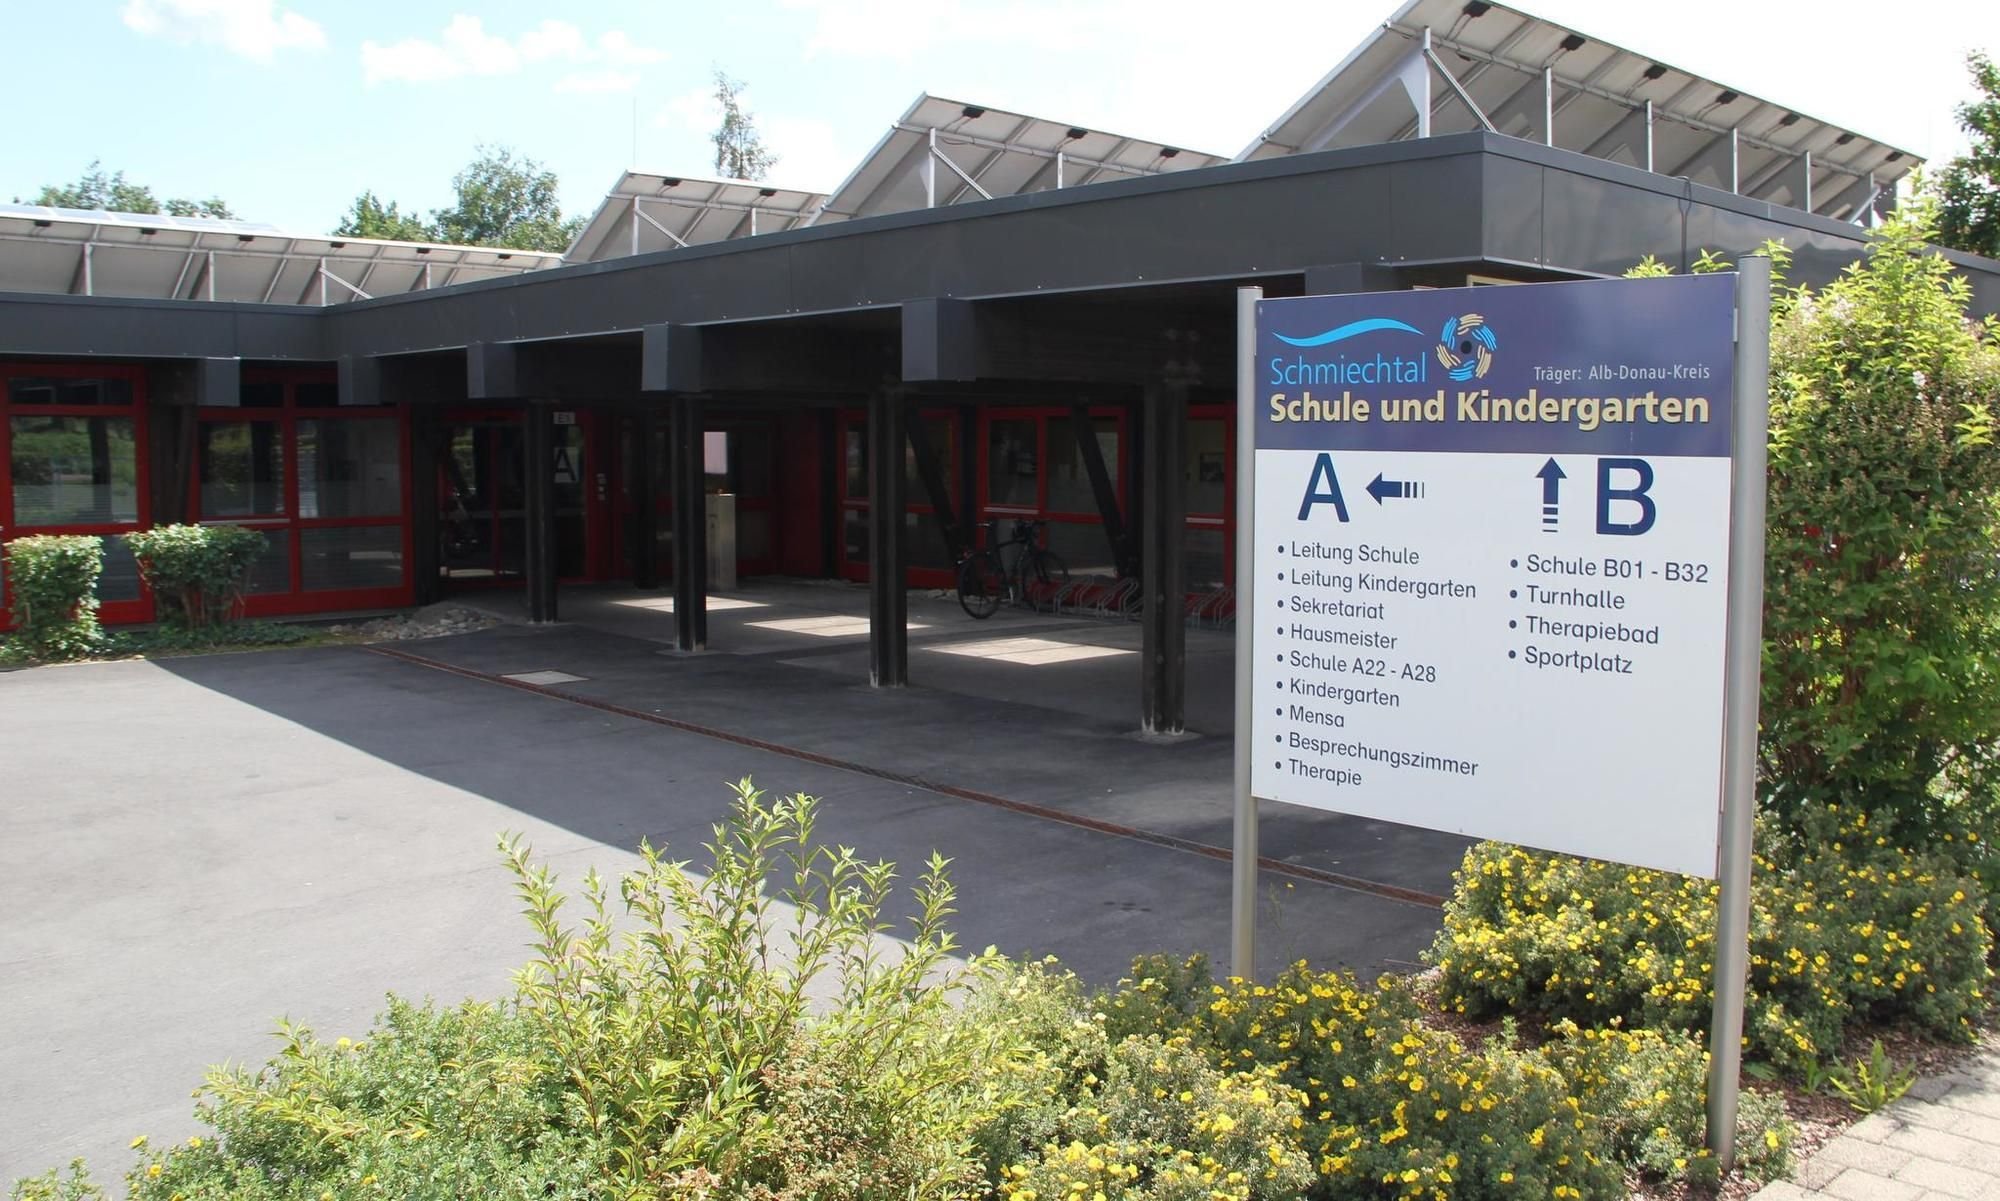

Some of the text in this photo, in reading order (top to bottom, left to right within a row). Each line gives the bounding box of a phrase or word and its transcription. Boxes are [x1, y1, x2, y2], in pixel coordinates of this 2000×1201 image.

[1270, 352, 1426, 385] Schmiechtal
[1534, 363, 1710, 385] Träger: Alb-Donau-Kreis
[1270, 389, 1710, 431] Schule und Kindergarten
[555, 447, 577, 483] A
[1297, 452, 1350, 523] A
[1595, 457, 1657, 537] B
[1291, 540, 1420, 565] Leitung Schule
[1291, 567, 1476, 599] Leitung Kindergarten
[1526, 553, 1597, 577] Schule
[1603, 558, 1644, 579] B01
[1665, 561, 1709, 584] B32
[1290, 595, 1385, 620] Sekretariat
[1526, 584, 1625, 610] Turnhalle
[1290, 623, 1398, 650] Hausmeister
[1525, 615, 1659, 645] Therapiebad
[1289, 649, 1348, 673] Schule
[1351, 657, 1386, 677] A22
[1400, 663, 1436, 683] A28
[1524, 645, 1633, 675] Sportplatz
[1289, 677, 1401, 708] Kindergarten
[1289, 704, 1345, 728] Mensa
[1288, 731, 1479, 777] Besprechungszimmer
[1288, 758, 1362, 787] Therapie
